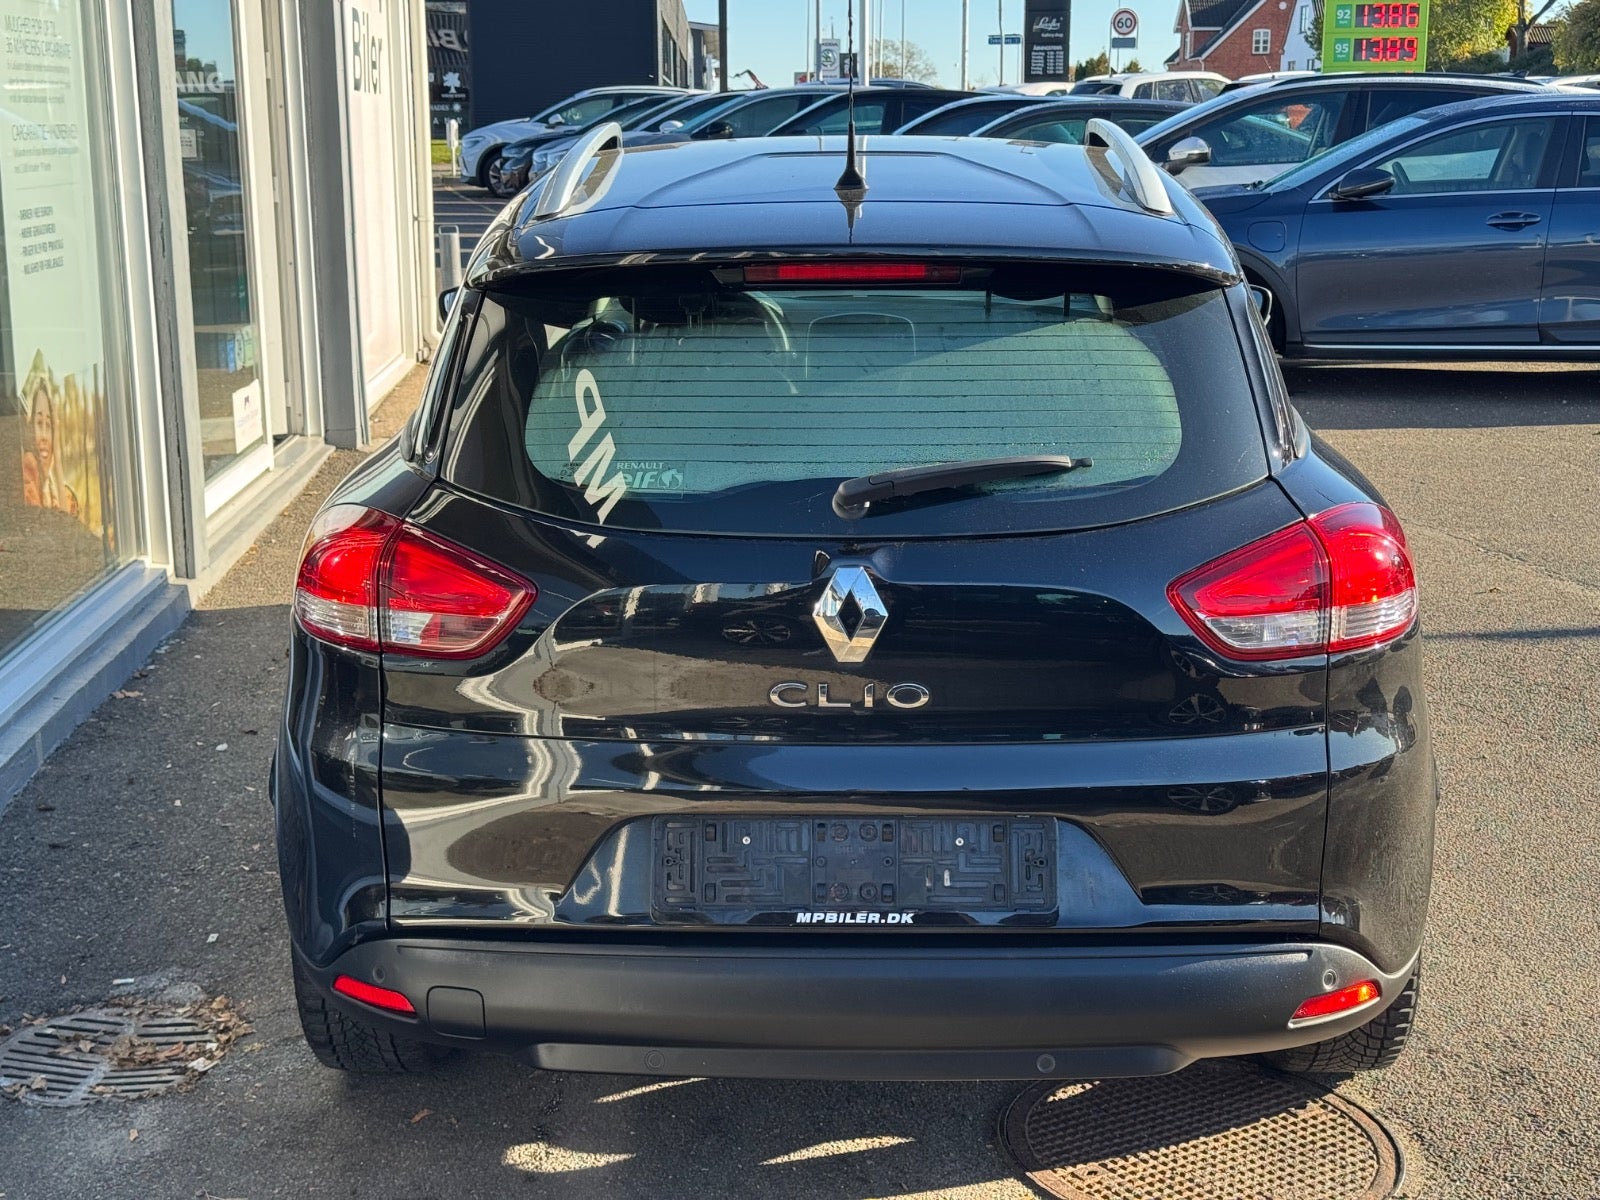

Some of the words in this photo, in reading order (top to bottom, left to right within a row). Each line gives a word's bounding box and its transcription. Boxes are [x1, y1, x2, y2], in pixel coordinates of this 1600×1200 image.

[1116, 17, 1133, 29] 60
[1337, 9, 1351, 20] 92
[1363, 2, 1419, 28] 13.86
[352, 7, 383, 94] Biler
[1334, 43, 1349, 54] 95
[1361, 36, 1417, 62] 13.89
[616, 462, 665, 470] RENAULT
[768, 682, 932, 709] CLIO
[795, 911, 915, 926] MPBILER.DK
